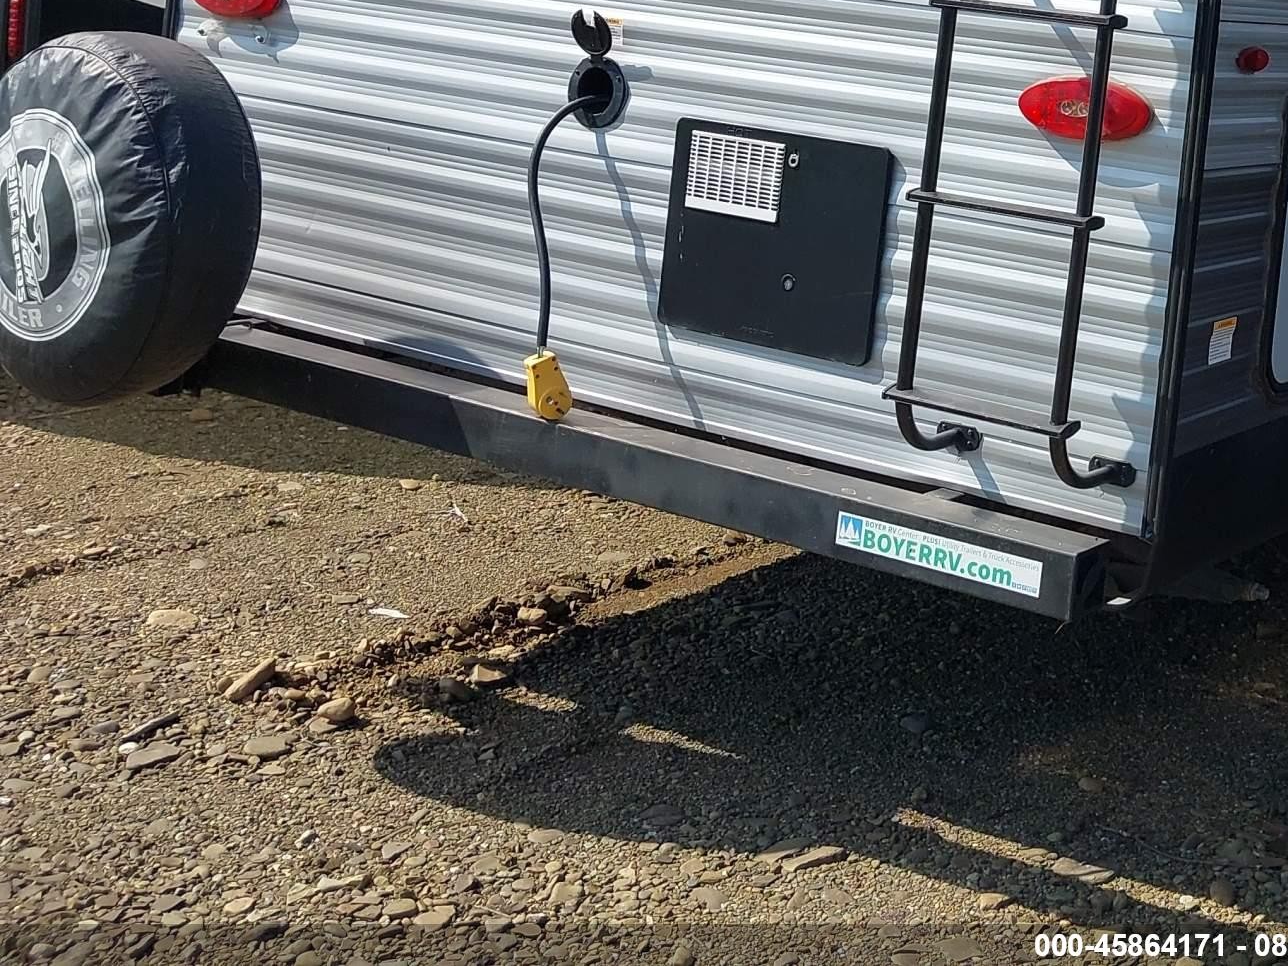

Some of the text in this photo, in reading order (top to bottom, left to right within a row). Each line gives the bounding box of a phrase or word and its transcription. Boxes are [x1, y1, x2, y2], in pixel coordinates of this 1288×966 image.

[7, 163, 21, 235] SINCE
[12, 235, 27, 303] 2005
[1, 293, 44, 328] ILER
[864, 520, 887, 532] BOYER
[888, 526, 897, 534] RV
[862, 528, 1012, 587] BOYERRV.com
